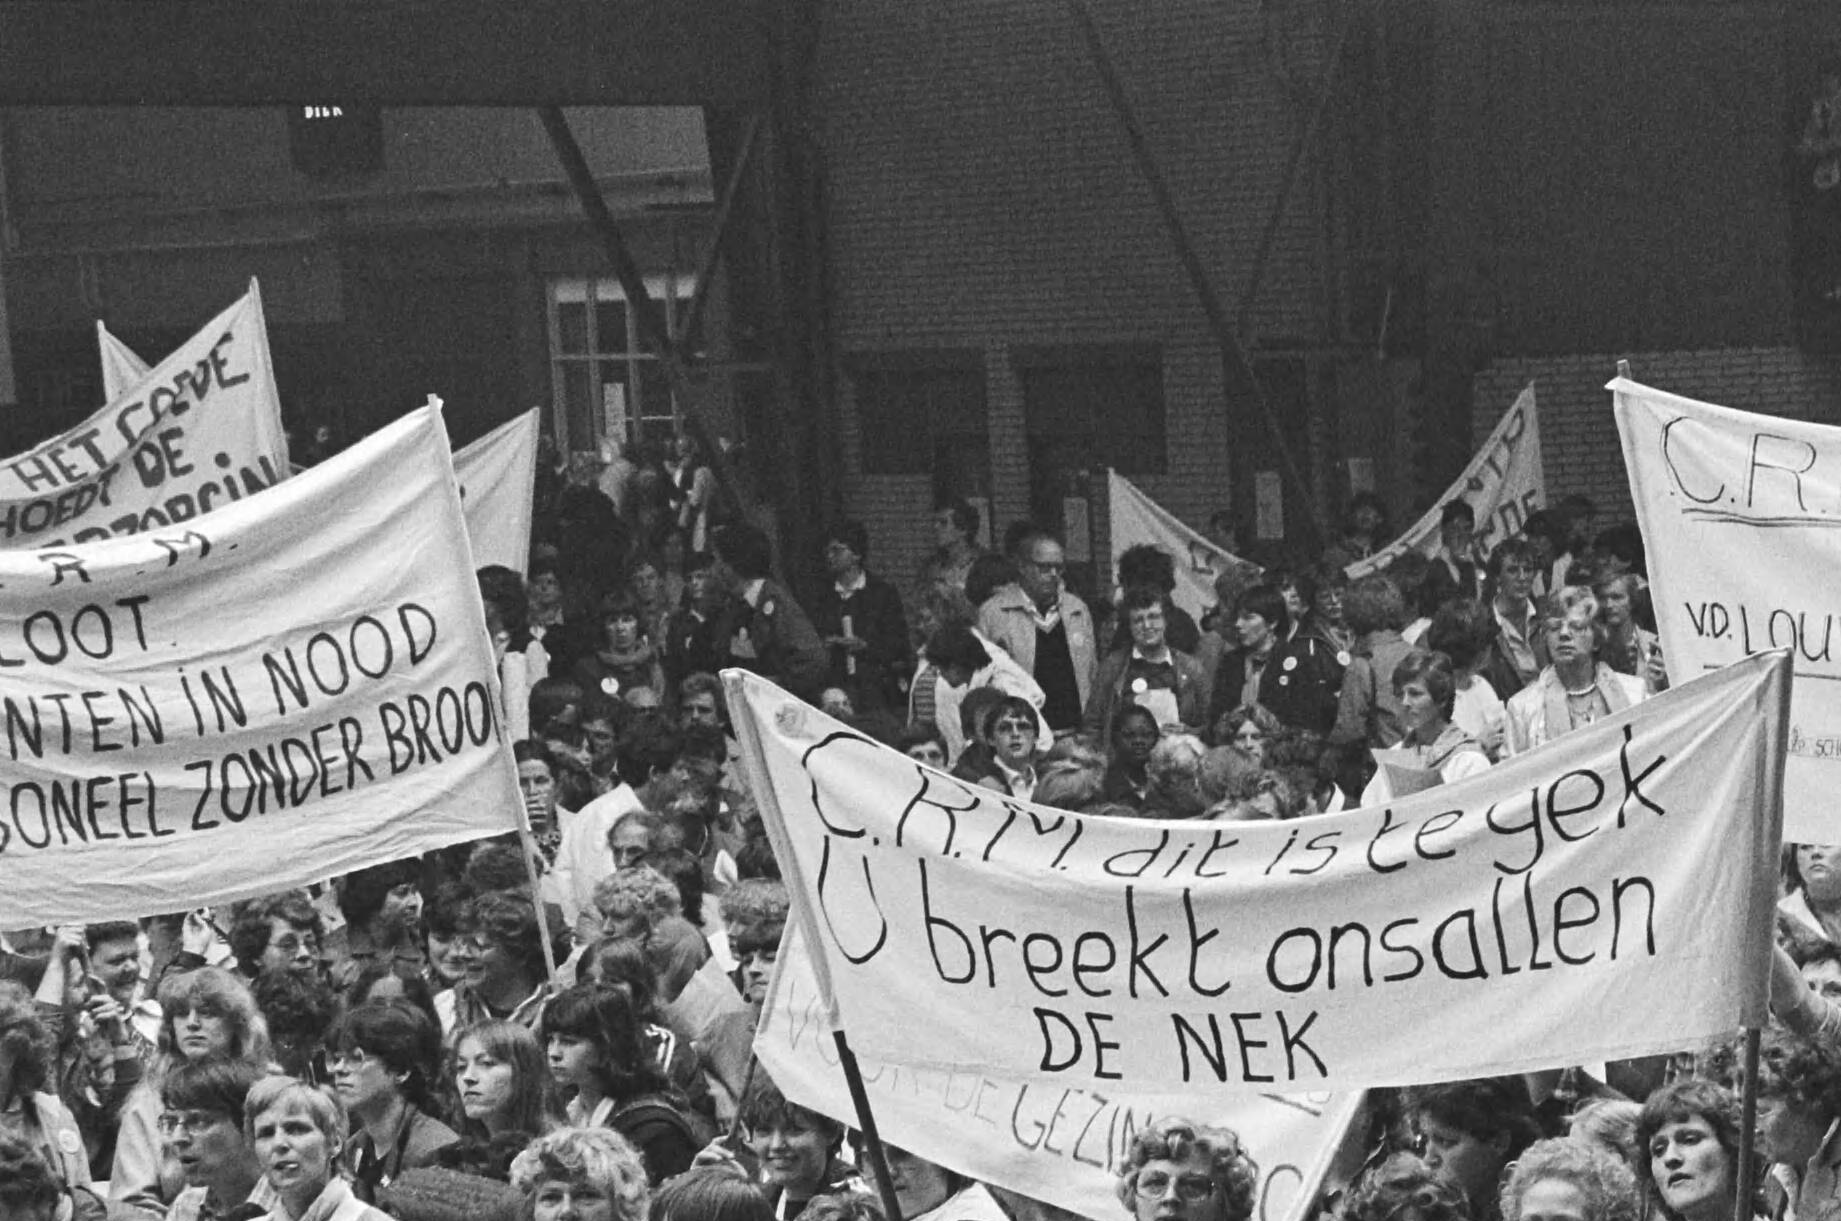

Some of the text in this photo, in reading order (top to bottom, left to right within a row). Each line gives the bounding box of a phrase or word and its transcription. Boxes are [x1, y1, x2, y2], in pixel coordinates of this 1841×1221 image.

[9, 428, 107, 492] HET
[132, 427, 194, 488] DE
[262, 602, 438, 716] NOOD
[184, 717, 374, 832] ZONDER
[1103, 829, 1239, 878] dit
[1265, 829, 1342, 876] is
[1367, 809, 1464, 874] te
[919, 857, 1231, 1000] breekt
[1034, 1007, 1328, 1083] DE NEK
